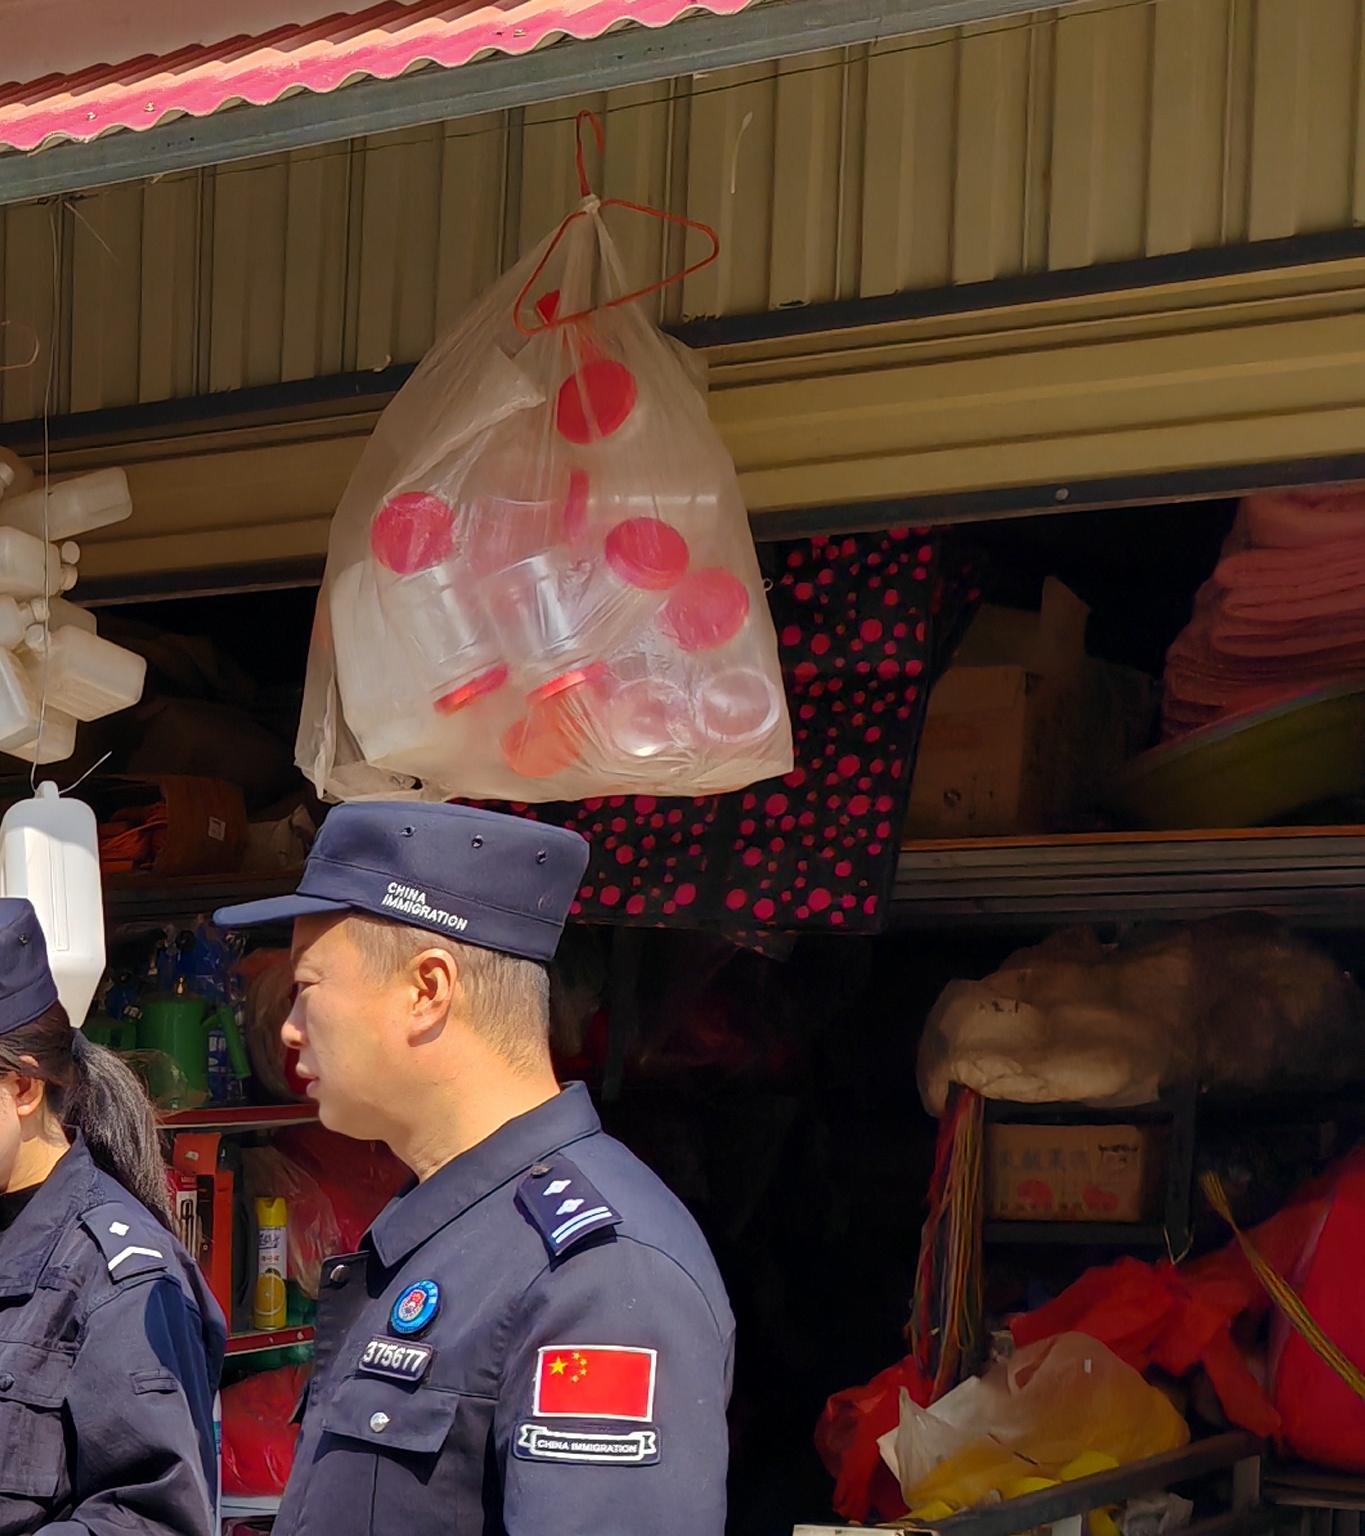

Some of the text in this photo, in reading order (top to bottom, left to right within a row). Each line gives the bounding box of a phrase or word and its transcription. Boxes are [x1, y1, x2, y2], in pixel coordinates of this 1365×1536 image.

[387, 881, 427, 905] CHINA
[381, 894, 468, 931] IMMIGRATION
[363, 1341, 428, 1373] 375677
[537, 1439, 638, 1454] CHINA IMMIGRATION
